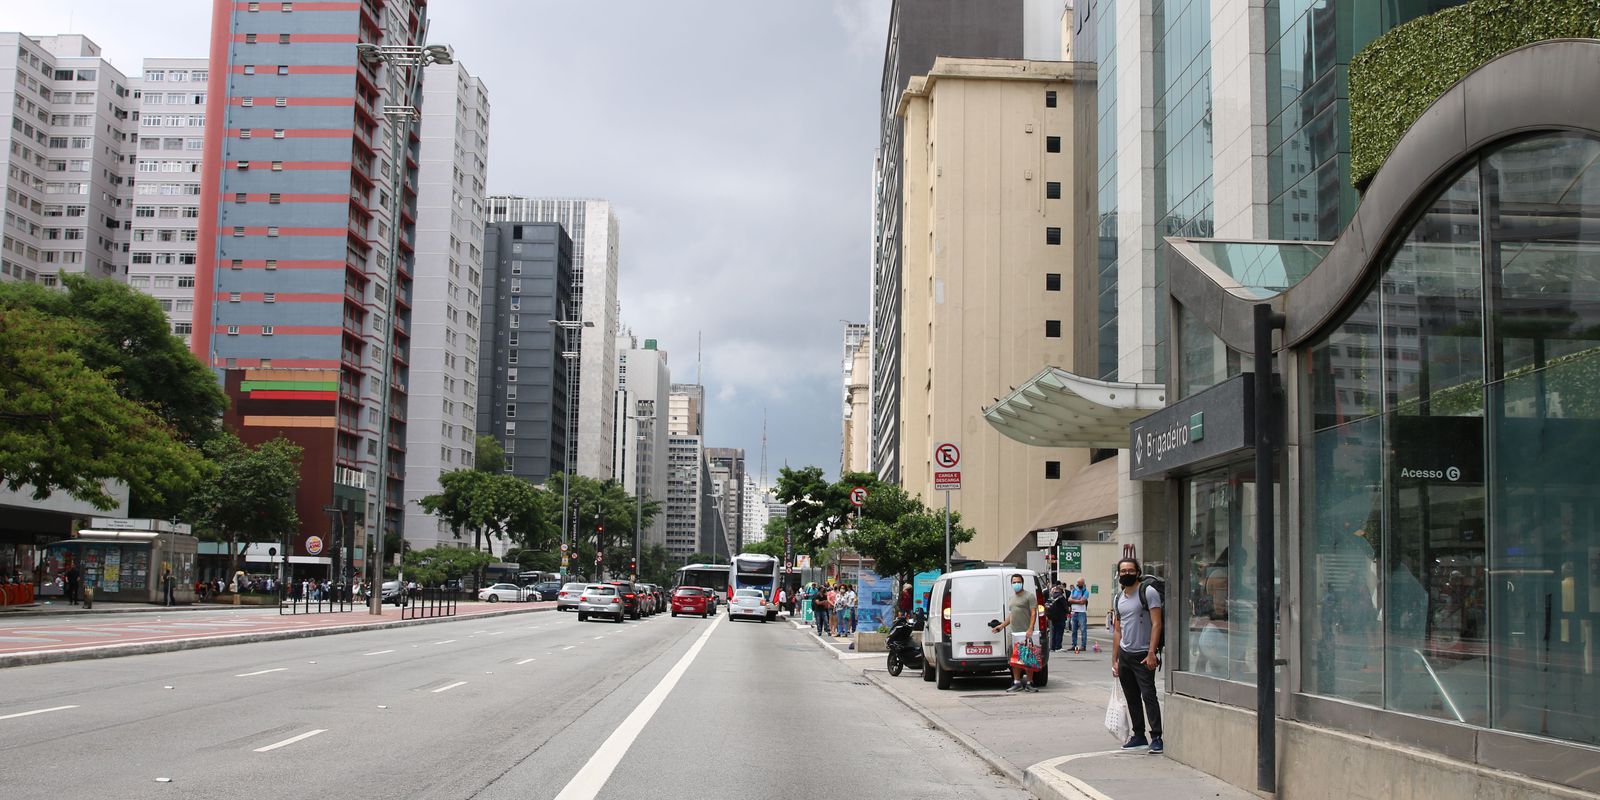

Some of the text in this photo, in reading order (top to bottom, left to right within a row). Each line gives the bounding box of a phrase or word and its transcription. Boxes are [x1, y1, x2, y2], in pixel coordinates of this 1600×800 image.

[1147, 421, 1188, 461] Brigadeiro
[943, 449, 952, 463] E
[1401, 467, 1443, 478] Acesso
